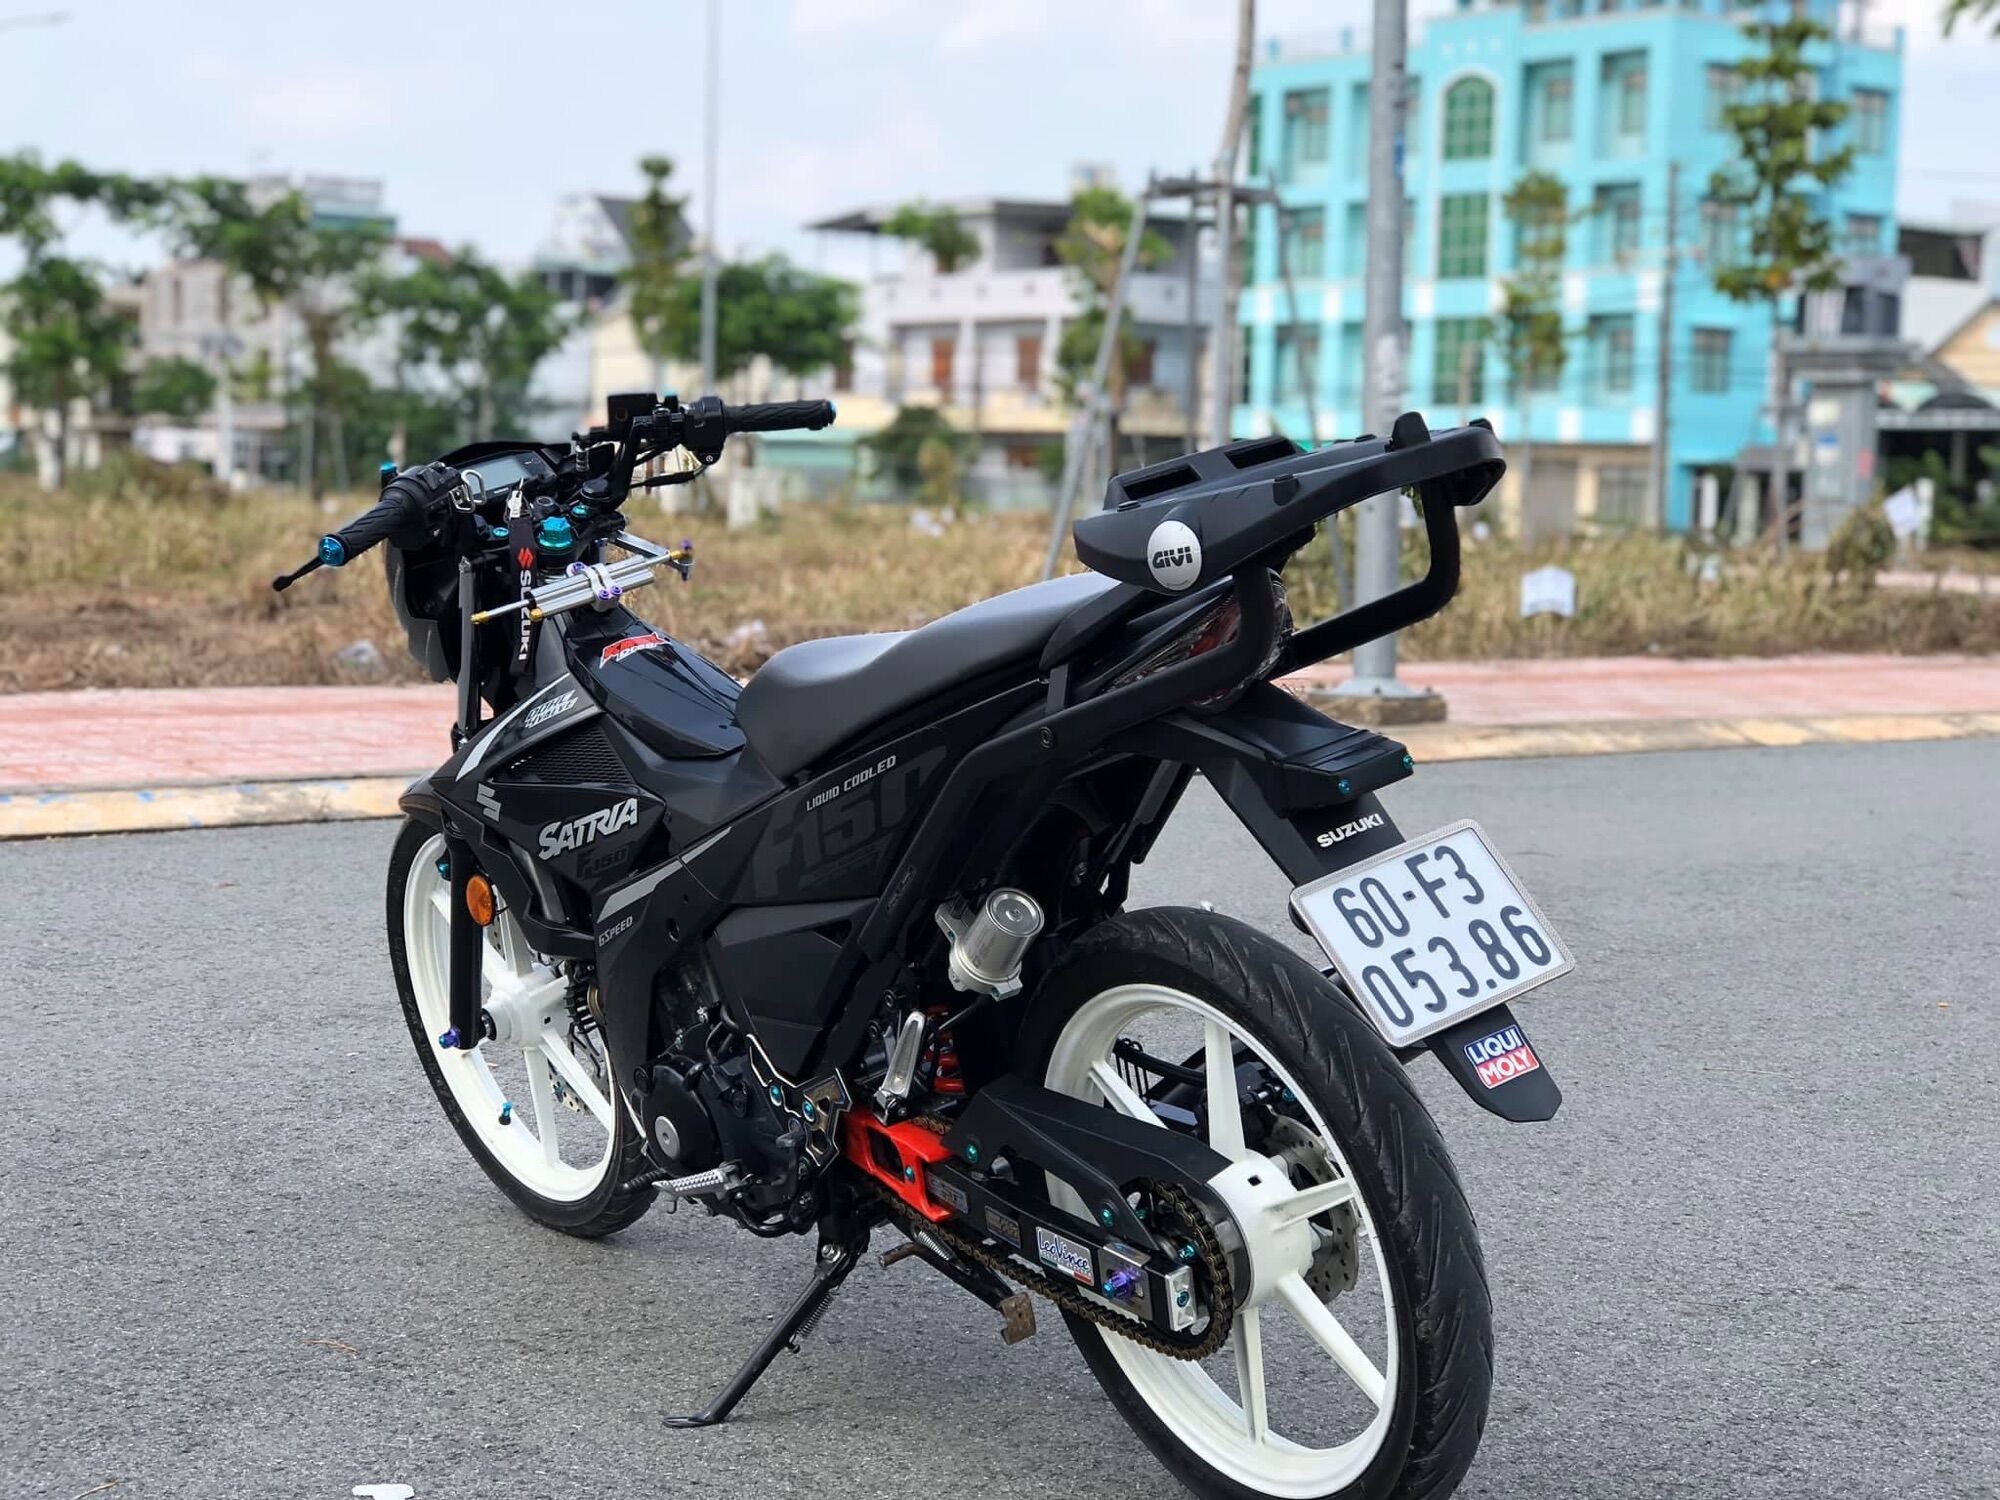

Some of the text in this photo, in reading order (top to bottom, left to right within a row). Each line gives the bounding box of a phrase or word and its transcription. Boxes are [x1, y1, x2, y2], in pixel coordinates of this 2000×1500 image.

[1152, 546, 1193, 569] GIVI
[806, 755, 897, 811] LIQUID COOLED
[538, 798, 638, 861] SATRIA
[1316, 813, 1384, 848] SUZUKI
[1333, 845, 1485, 948] 60-F3
[1362, 905, 1551, 1028] 053.86
[1467, 1026, 1523, 1064] LIQUI
[1477, 1047, 1537, 1085] MOLY
[1038, 1231, 1089, 1270] LeoVince
